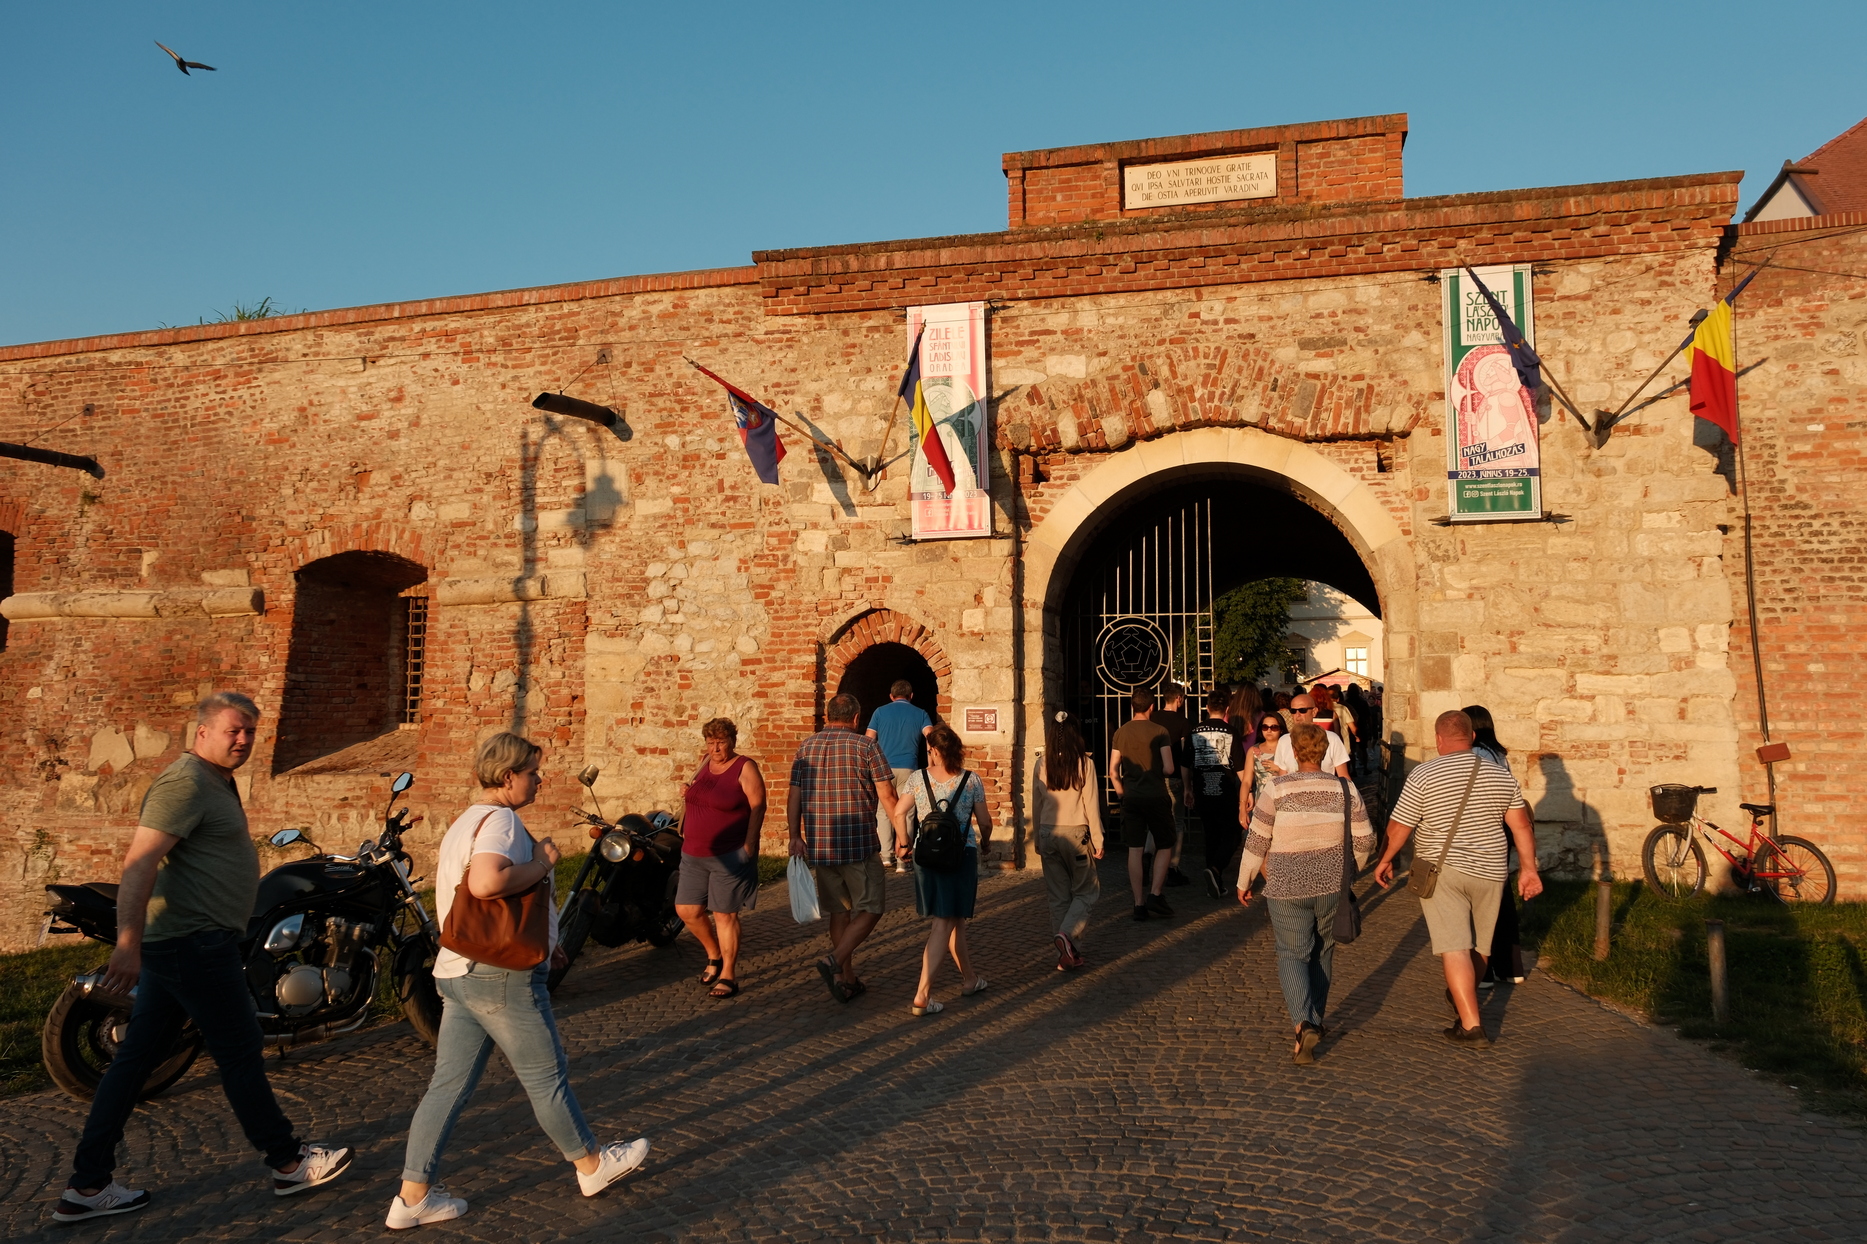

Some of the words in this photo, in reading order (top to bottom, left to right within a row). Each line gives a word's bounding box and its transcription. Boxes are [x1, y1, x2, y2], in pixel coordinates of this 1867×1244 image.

[1147, 171, 1161, 180] DEO
[1167, 169, 1180, 177] VNI
[1185, 165, 1221, 176] TRINOQVE
[1226, 162, 1251, 172] GRATIE
[1131, 183, 1144, 192] QVI
[1148, 181, 1163, 190] IPSA
[1168, 178, 1202, 188] SALVTARI
[1206, 175, 1231, 184] HOSTIE
[1237, 172, 1269, 182] SACRATA
[1142, 192, 1152, 201] DIE
[1158, 190, 1178, 200] OSTIA
[1184, 187, 1218, 197] APERUVIT
[1224, 183, 1259, 193] VARADINI
[1466, 317, 1500, 331] NAPO
[929, 327, 964, 340] ZILELE
[929, 351, 965, 362] LADISLAU
[930, 363, 966, 372] ORADEA
[1463, 443, 1485, 456] NAGY
[1471, 443, 1524, 465] TALÁLKOZÁS
[1479, 468, 1502, 479] JÚNIUS
